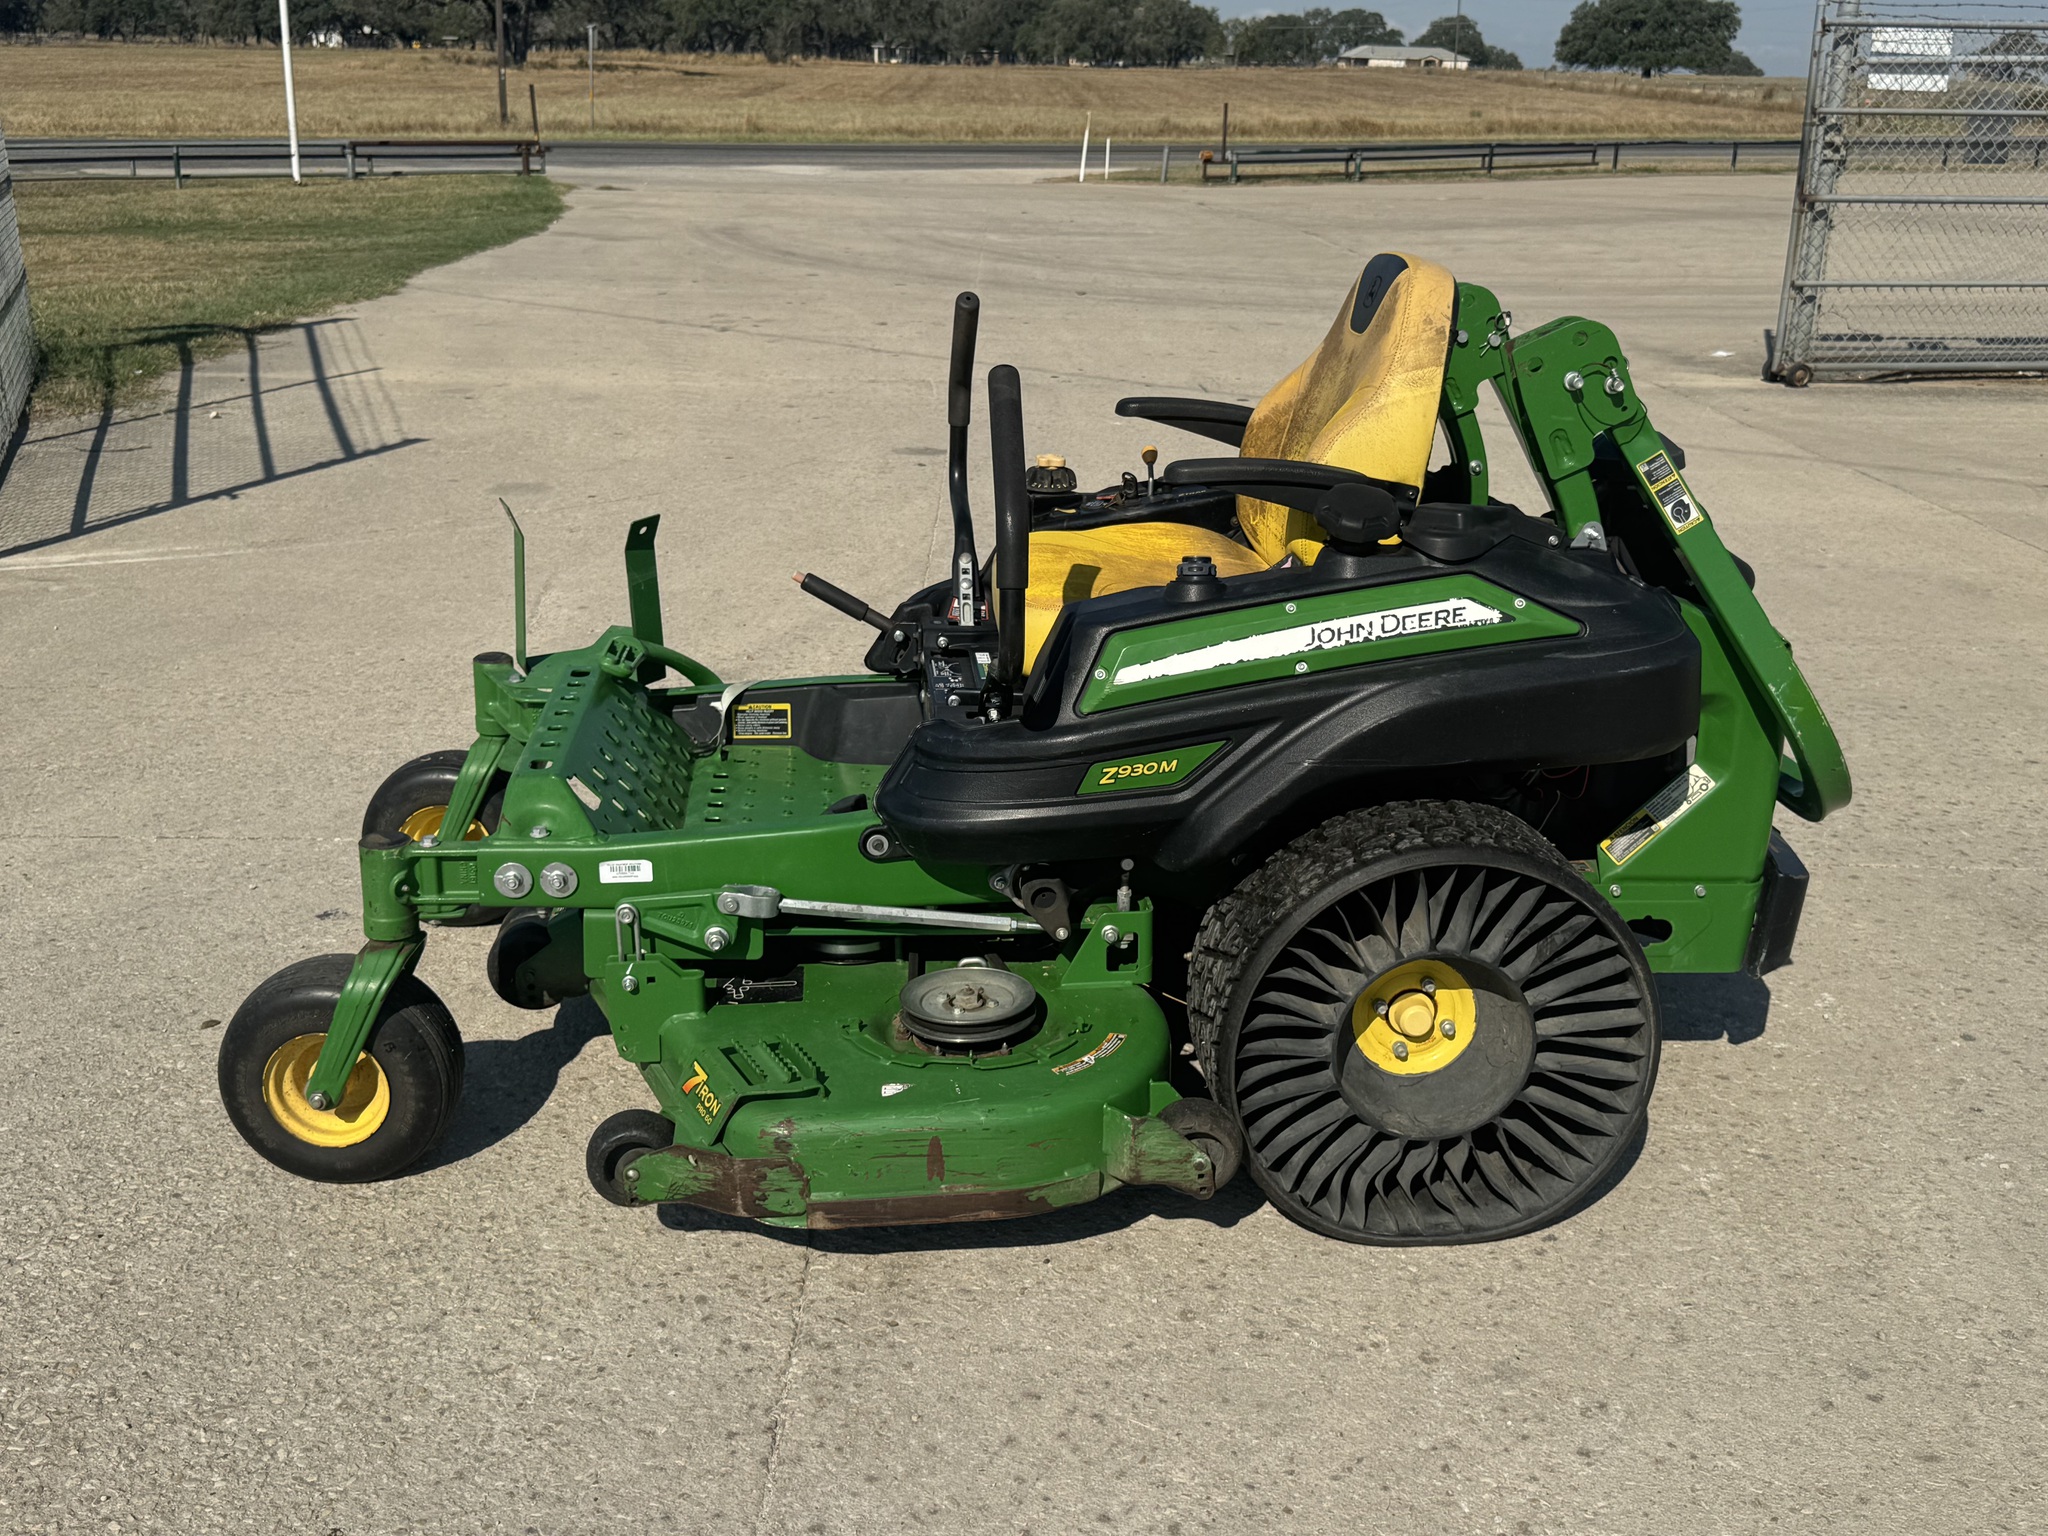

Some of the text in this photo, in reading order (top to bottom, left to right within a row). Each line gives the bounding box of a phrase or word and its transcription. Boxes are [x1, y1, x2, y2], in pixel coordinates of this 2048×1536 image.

[1304, 606, 1467, 648] JOHN DEERE
[1098, 759, 1178, 785] Z930M
[681, 1060, 721, 1117] 7 IRON
[695, 1102, 707, 1117] PRO
